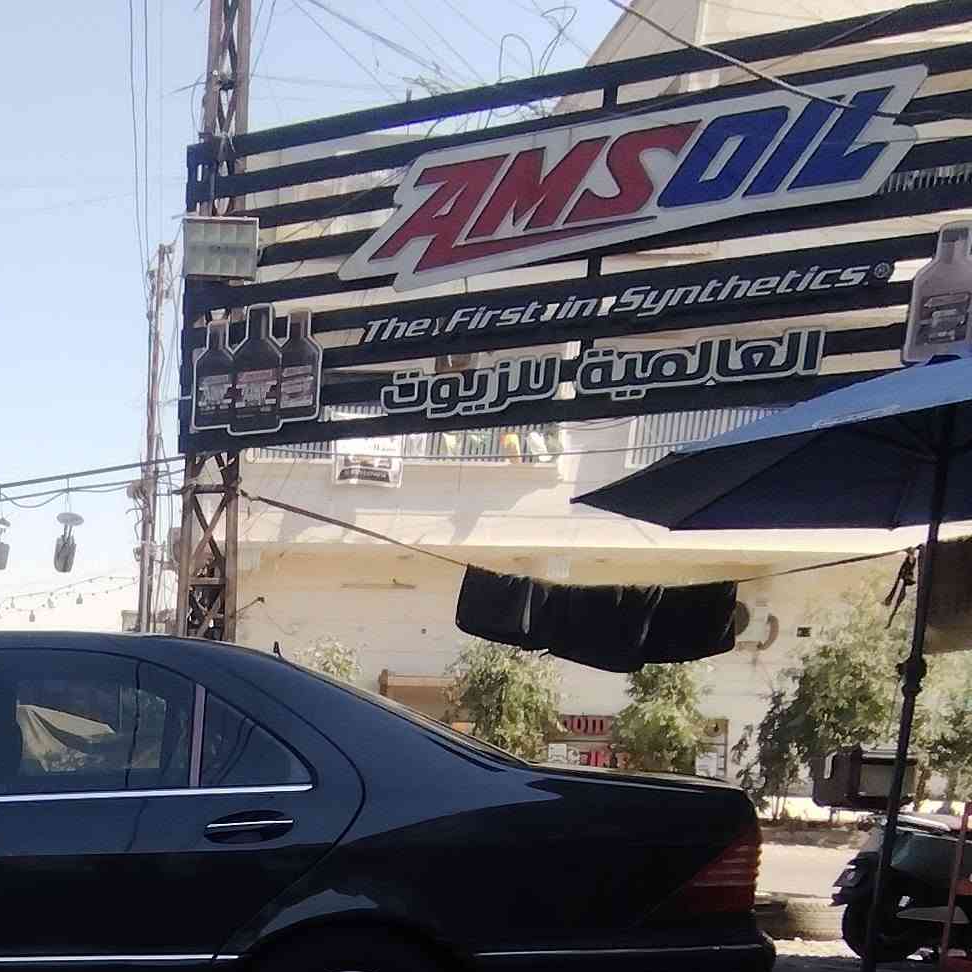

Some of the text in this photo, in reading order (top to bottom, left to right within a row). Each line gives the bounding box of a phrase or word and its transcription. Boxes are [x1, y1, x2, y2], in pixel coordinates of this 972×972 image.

[369, 85, 890, 275] AMSOIL
[363, 316, 431, 344] The
[444, 303, 545, 333] First
[555, 294, 598, 320] in
[379, 352, 562, 419] للزيوت
[578, 325, 827, 401] العالمية
